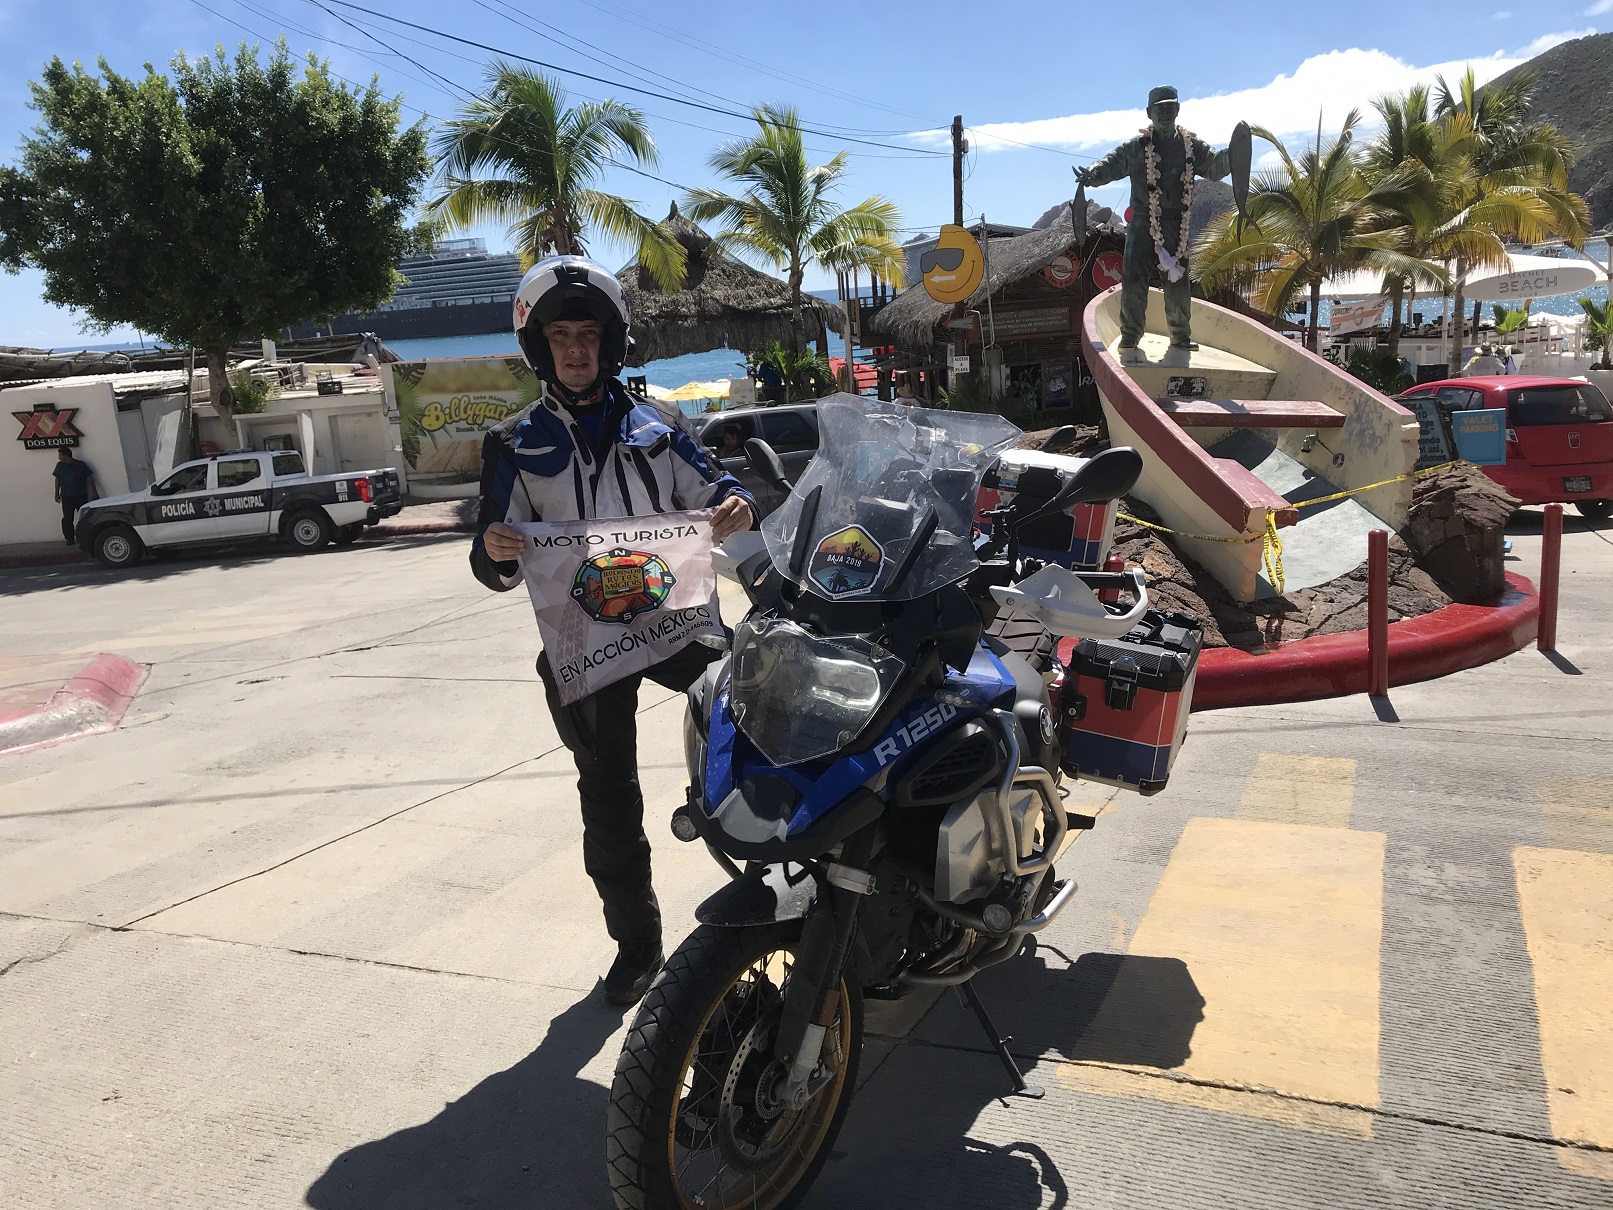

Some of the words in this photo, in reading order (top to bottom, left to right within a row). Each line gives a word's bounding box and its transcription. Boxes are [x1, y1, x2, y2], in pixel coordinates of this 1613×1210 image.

[1499, 276, 1558, 293] BEACH
[420, 395, 518, 431] Billygan'
[1462, 415, 1495, 424] VALET
[1459, 424, 1499, 433] PARKING
[27, 439, 46, 447] DOS
[47, 437, 74, 446] EQUIS
[338, 494, 348, 502] 911
[161, 500, 195, 517] POLICÍA
[224, 495, 264, 510] MUNICIPAL
[533, 533, 605, 548] MOTO
[611, 524, 699, 544] TURISTA
[827, 554, 844, 565] BAJA
[845, 556, 862, 567] 2019
[623, 612, 632, 620] S
[559, 662, 581, 684] EN
[583, 632, 648, 673] ACCIÓN
[649, 606, 710, 642] MÉXICO
[667, 633, 682, 646] RRM
[873, 736, 901, 767] R
[896, 703, 957, 748] 1250
